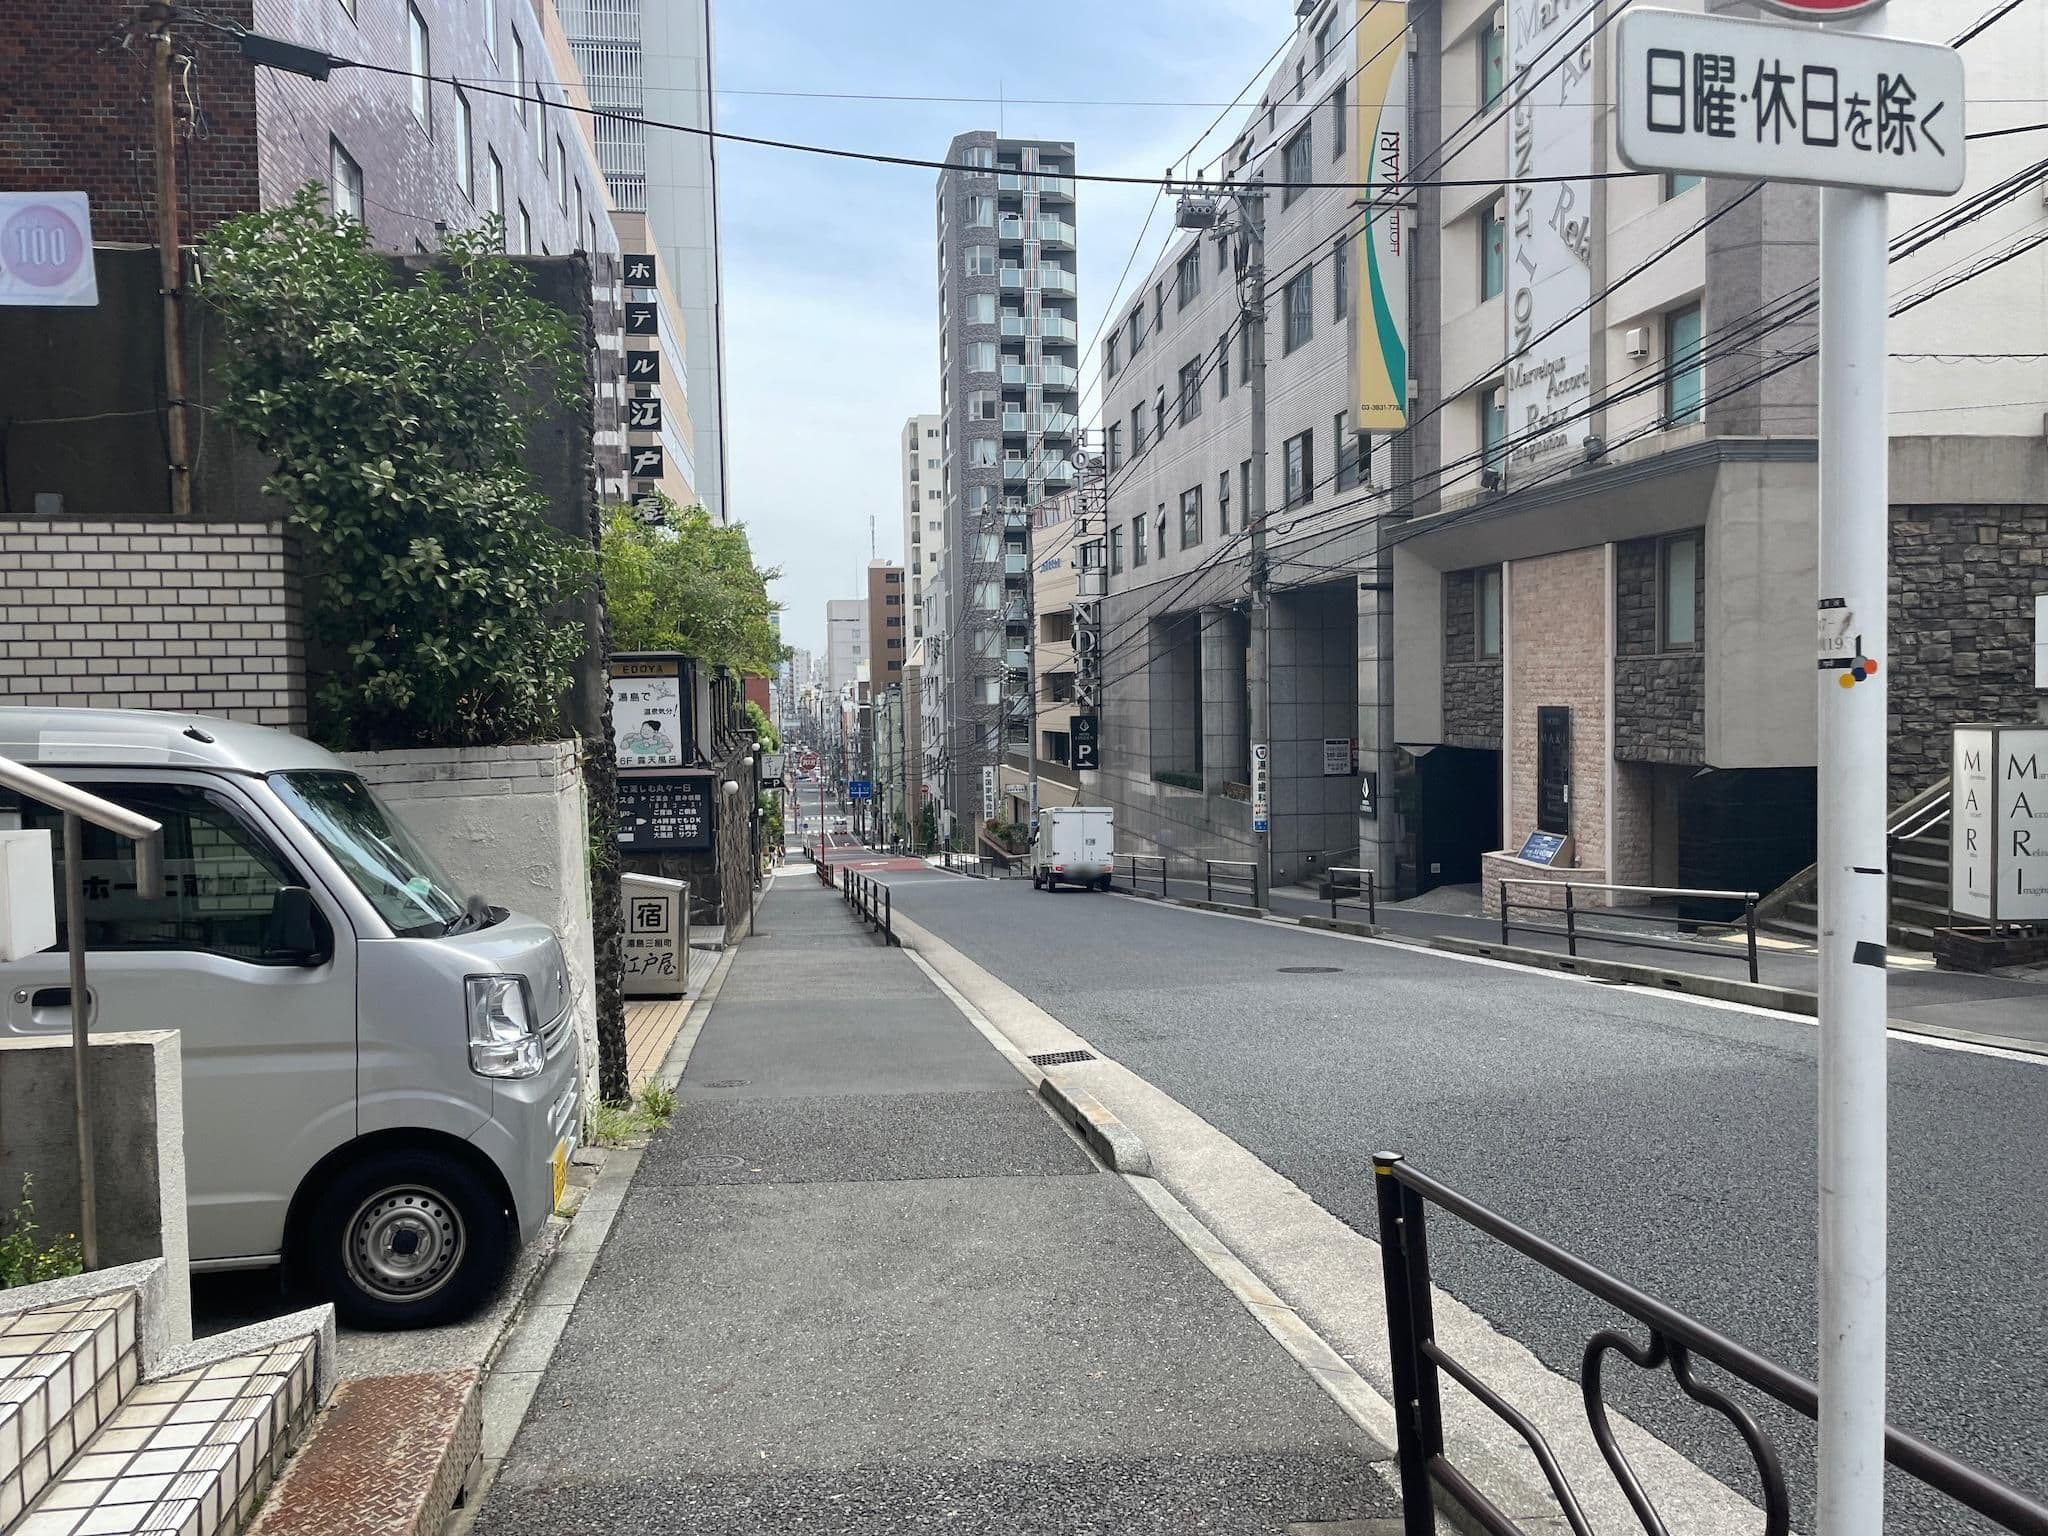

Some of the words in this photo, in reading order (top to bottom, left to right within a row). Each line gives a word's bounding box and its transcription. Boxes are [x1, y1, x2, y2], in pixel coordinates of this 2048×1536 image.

[1647, 48, 1945, 157] 日曜・休日を除く
[1381, 132, 1400, 195] MARI
[1509, 357, 1566, 392] Marvelous
[1546, 365, 1589, 399] Accord
[1071, 428, 1089, 537] HOTEL
[622, 665, 664, 674] EDOYA
[1079, 744, 1092, 760] P
[637, 902, 662, 927] 宿
[623, 952, 677, 975] 江戸屋
